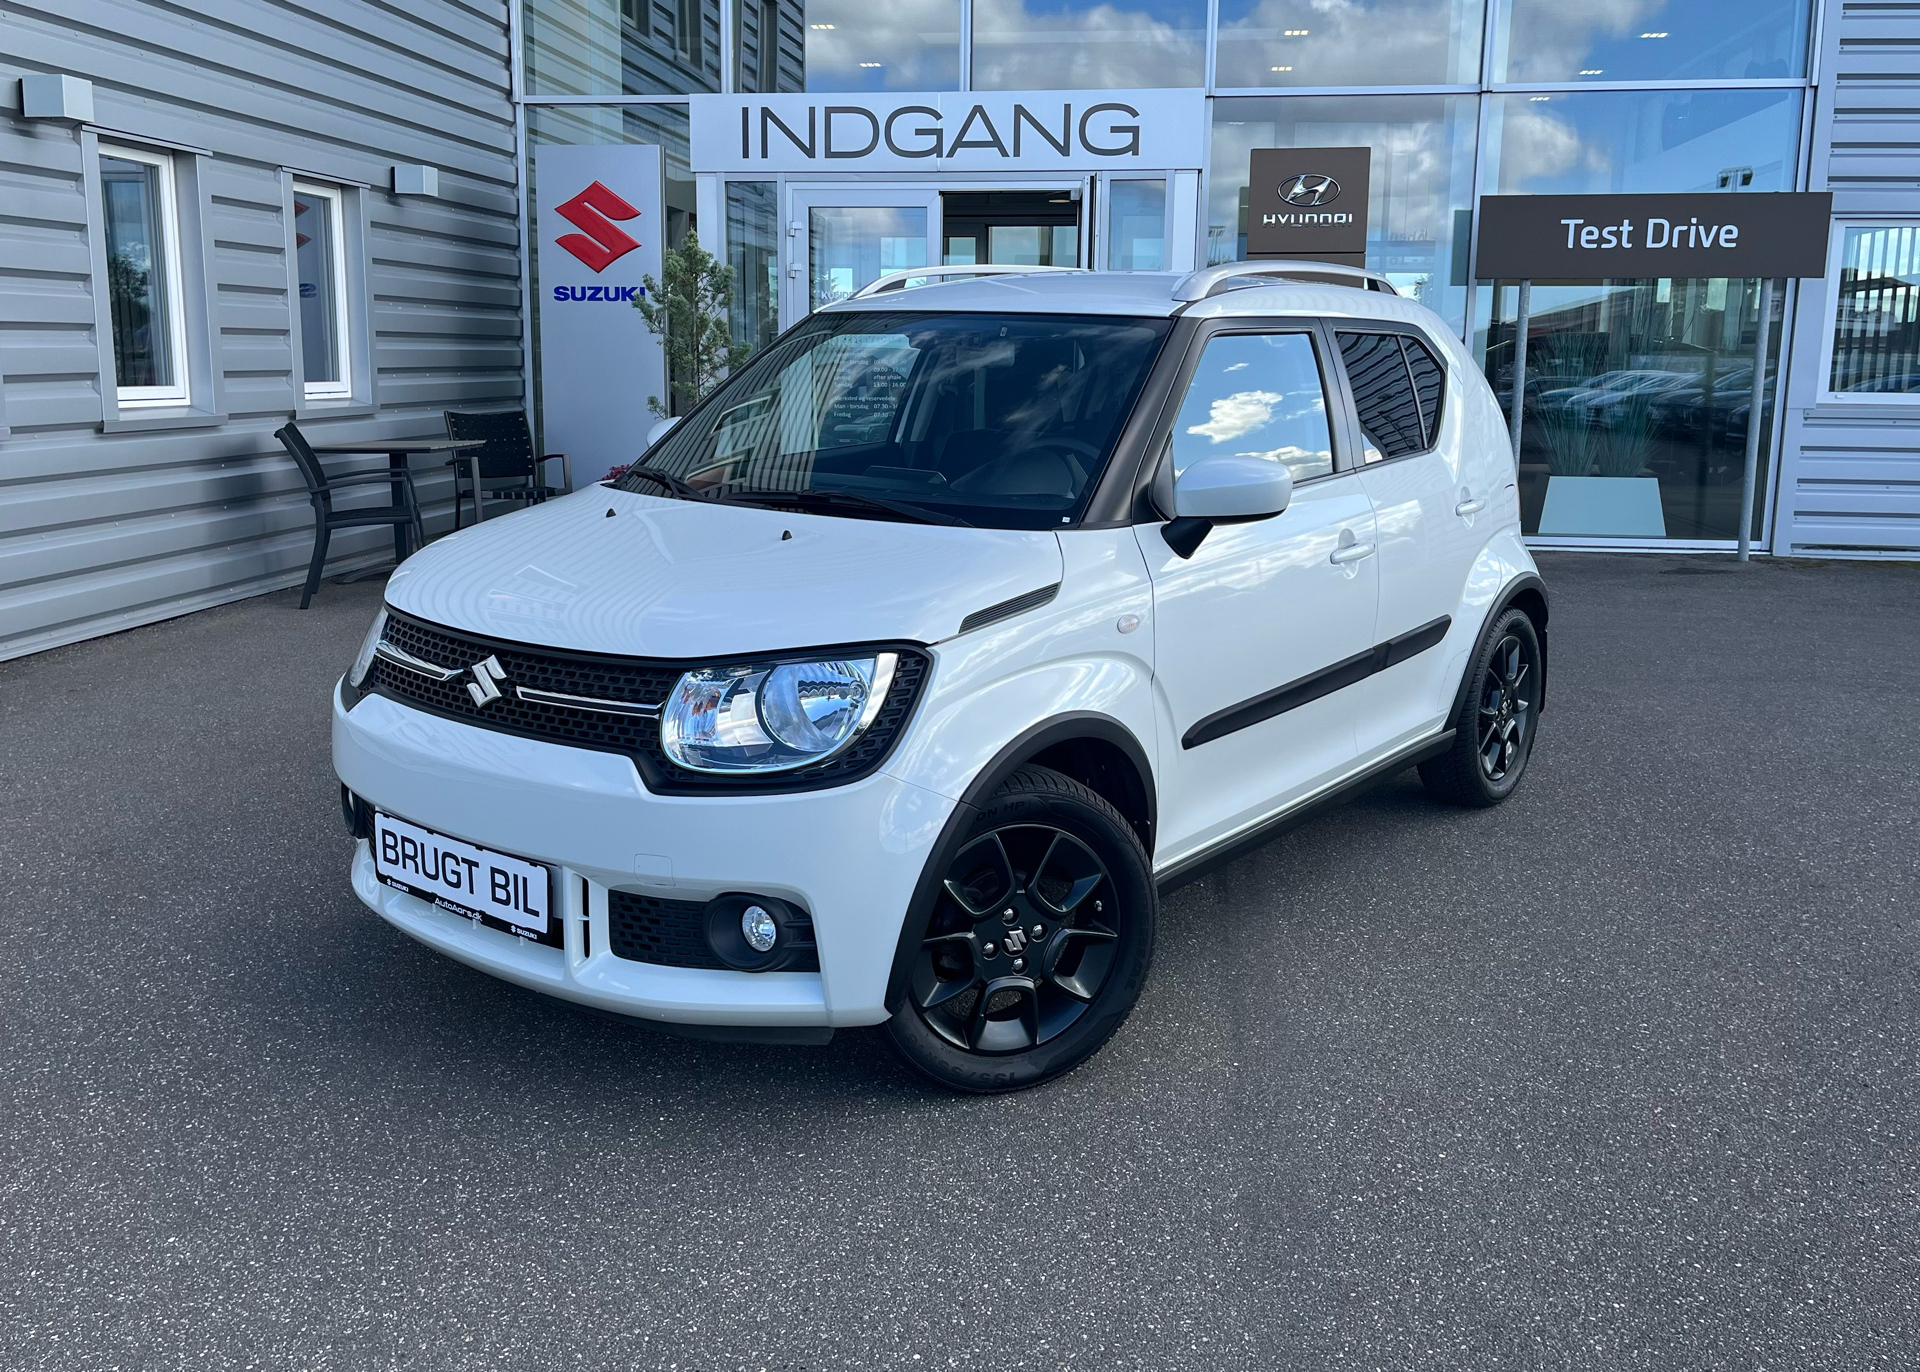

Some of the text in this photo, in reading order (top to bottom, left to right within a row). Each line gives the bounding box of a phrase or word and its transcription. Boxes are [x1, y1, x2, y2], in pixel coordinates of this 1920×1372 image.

[741, 102, 1141, 160] INDGANG
[1262, 213, 1353, 225] HYUNDAI
[1560, 217, 1739, 249] Test Drive
[553, 285, 646, 302] SUZUKI
[381, 828, 540, 918] BRUGT BIL
[391, 881, 409, 893] SUZUKI
[434, 897, 483, 922] AutoAars.dk
